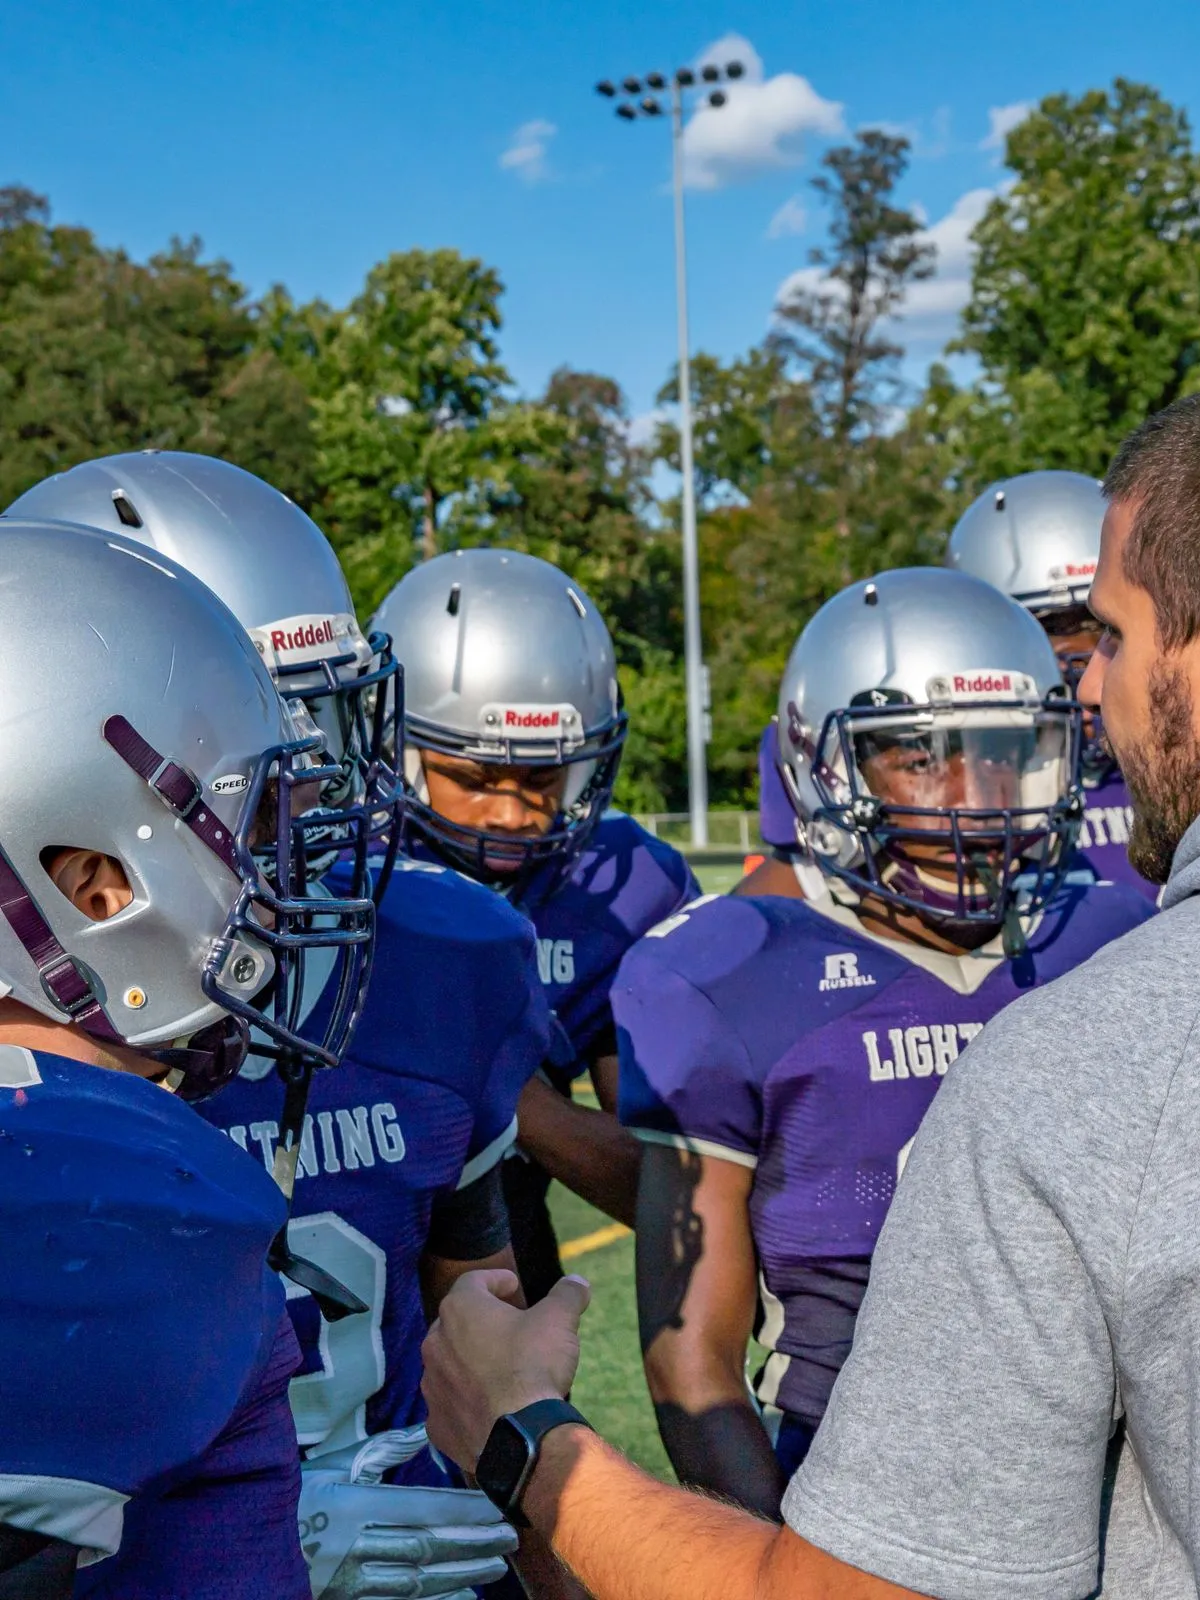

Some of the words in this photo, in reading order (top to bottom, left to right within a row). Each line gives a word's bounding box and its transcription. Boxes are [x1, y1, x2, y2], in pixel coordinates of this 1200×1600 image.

[271, 620, 334, 651] Riddell
[953, 676, 1011, 692] Riddell
[505, 710, 559, 727] Riddell
[214, 778, 249, 792] SPEED
[818, 974, 877, 992] RUSSELL
